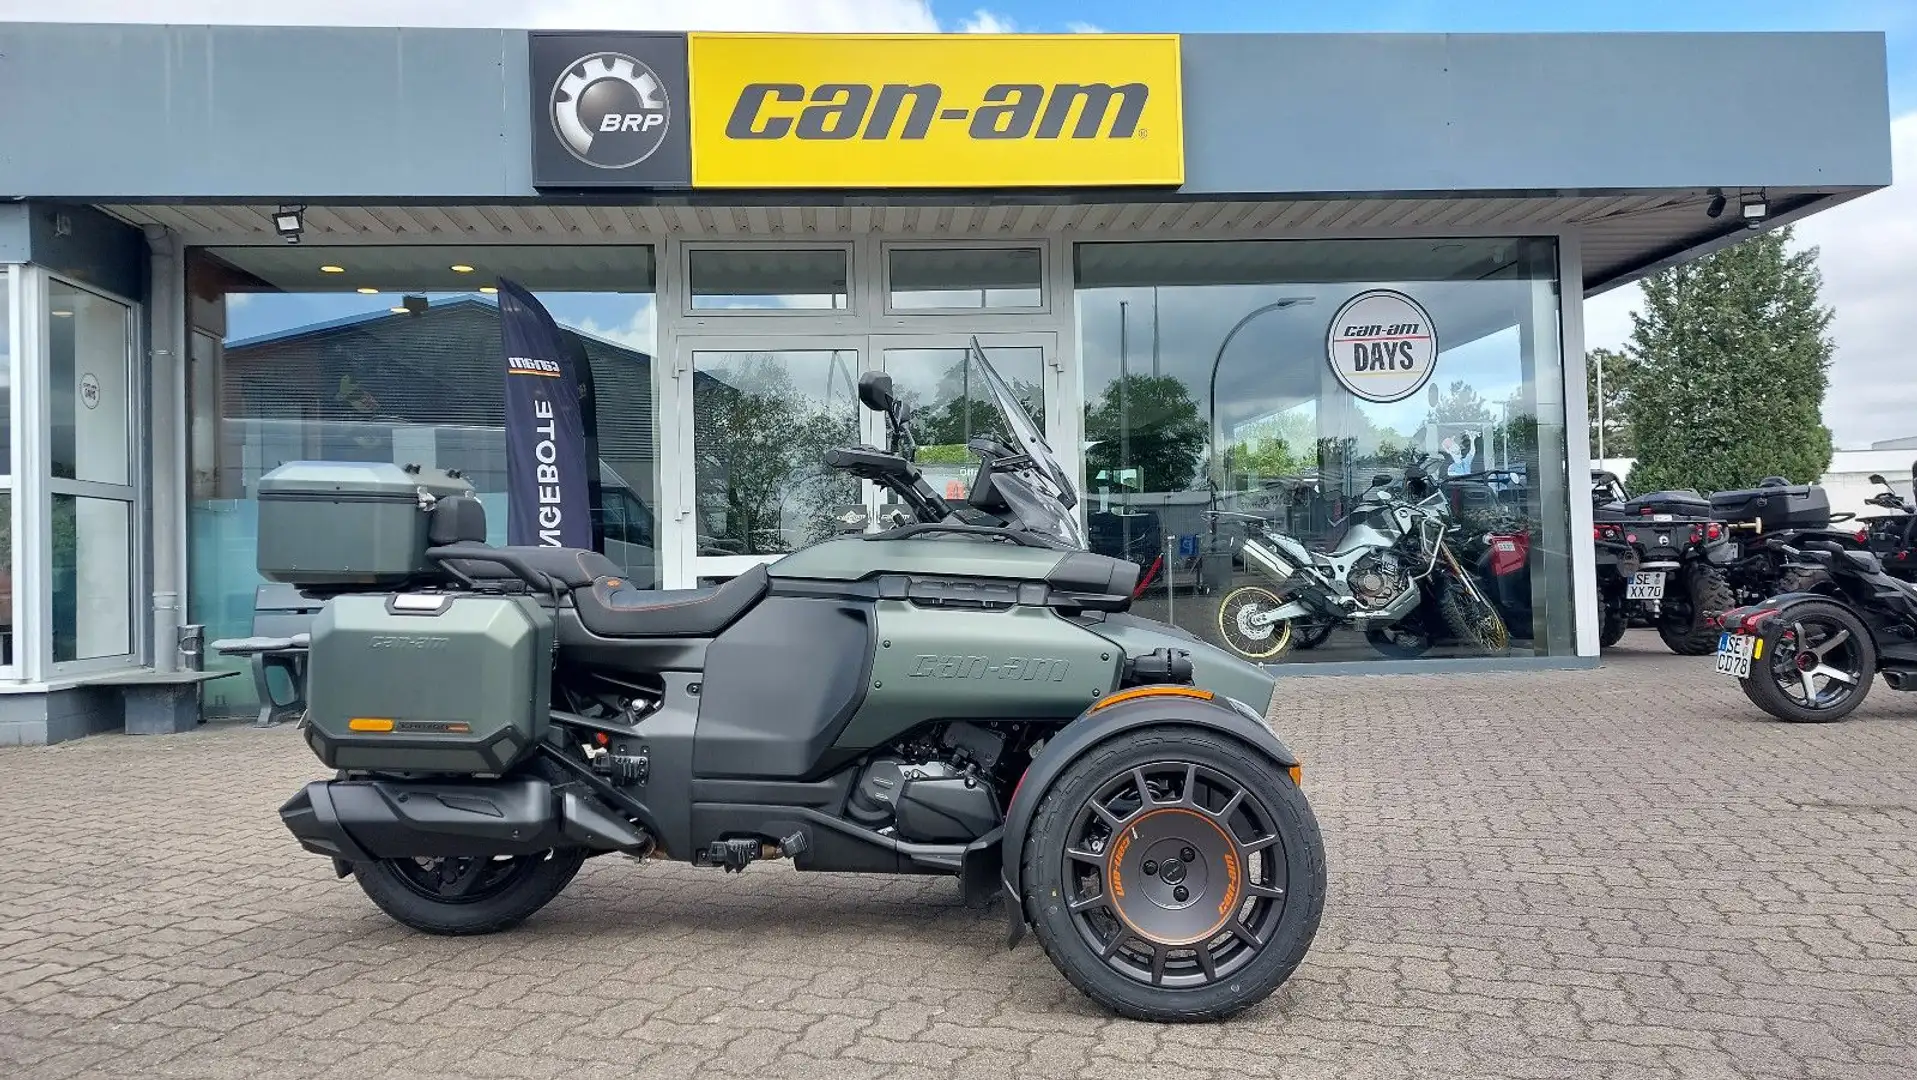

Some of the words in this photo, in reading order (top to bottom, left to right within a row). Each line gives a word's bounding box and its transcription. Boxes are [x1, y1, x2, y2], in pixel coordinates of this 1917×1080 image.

[724, 82, 1149, 140] can-am
[599, 113, 664, 132] BRP
[1343, 323, 1420, 337] can-am
[1353, 340, 1414, 372] DAYS
[1635, 573, 1651, 585] SE
[1630, 586, 1645, 597] XX
[1647, 586, 1661, 597] 70
[1726, 636, 1742, 655] SE
[908, 653, 1071, 683] can-am
